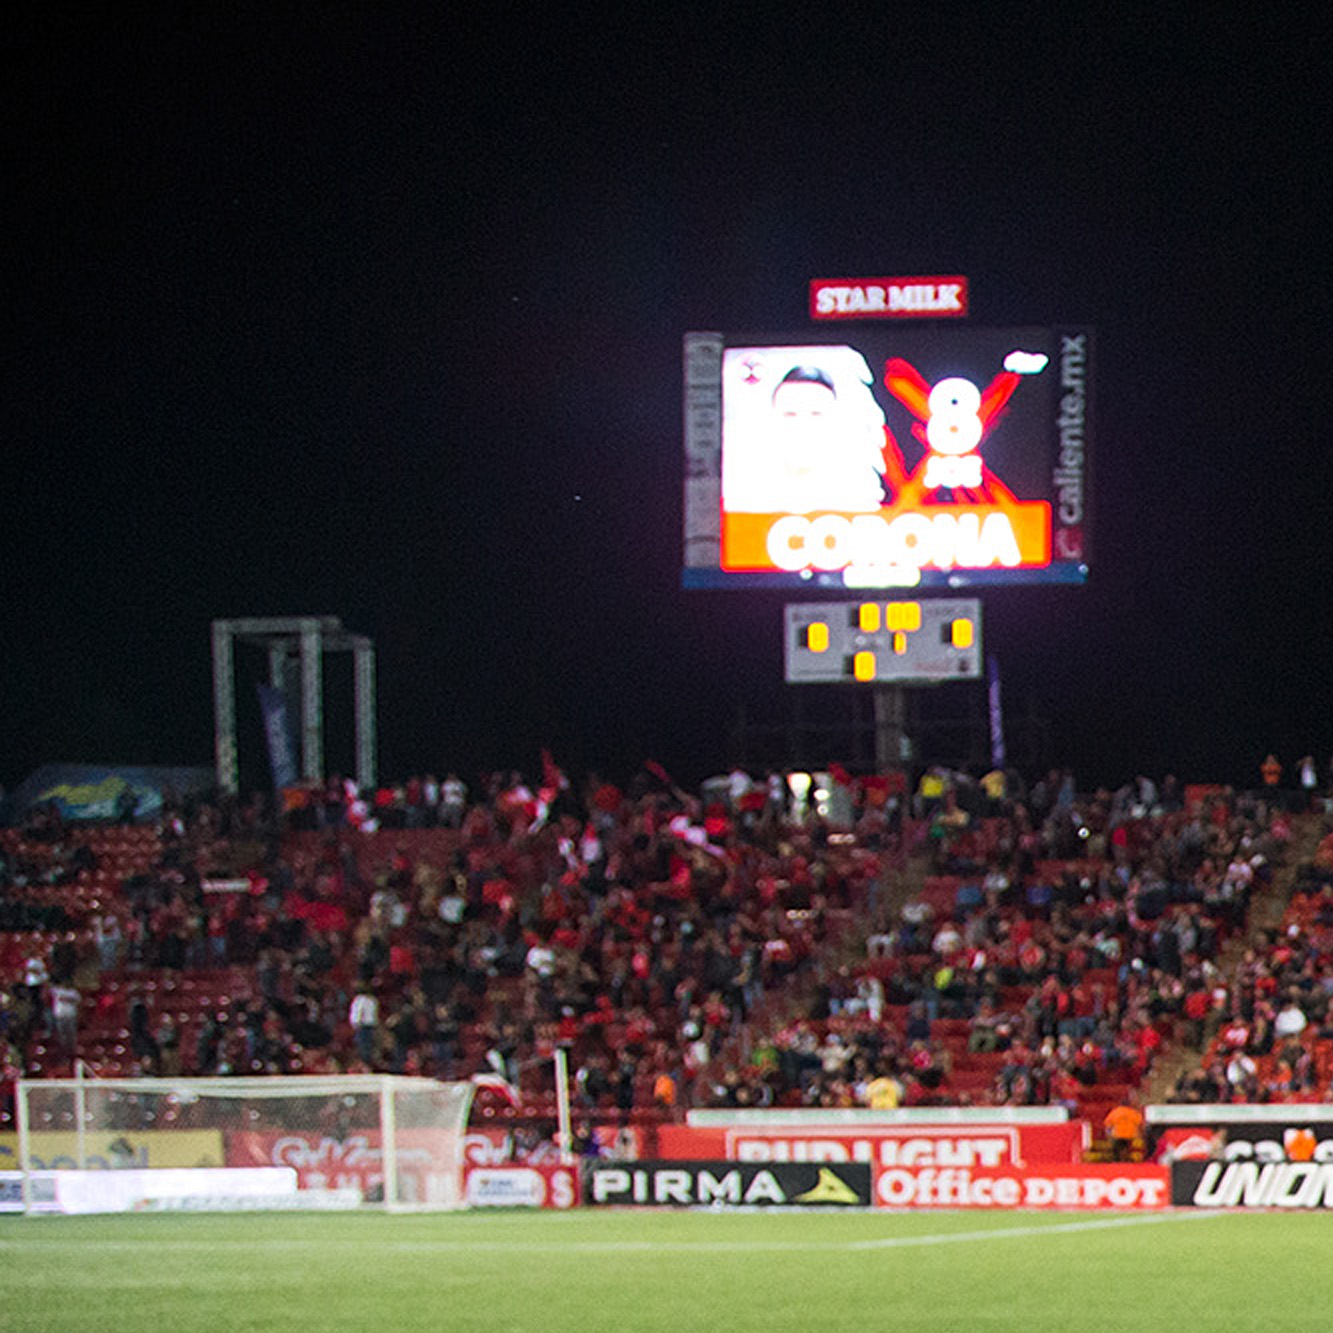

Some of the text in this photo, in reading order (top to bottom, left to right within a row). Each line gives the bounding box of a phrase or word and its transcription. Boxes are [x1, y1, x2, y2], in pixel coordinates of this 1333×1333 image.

[816, 284, 962, 313] STAR MILK
[926, 377, 983, 455] 8
[1053, 333, 1087, 524] caliente.mx
[593, 1168, 787, 1204] PIRMA
[877, 1167, 1166, 1206] Office DEPOT
